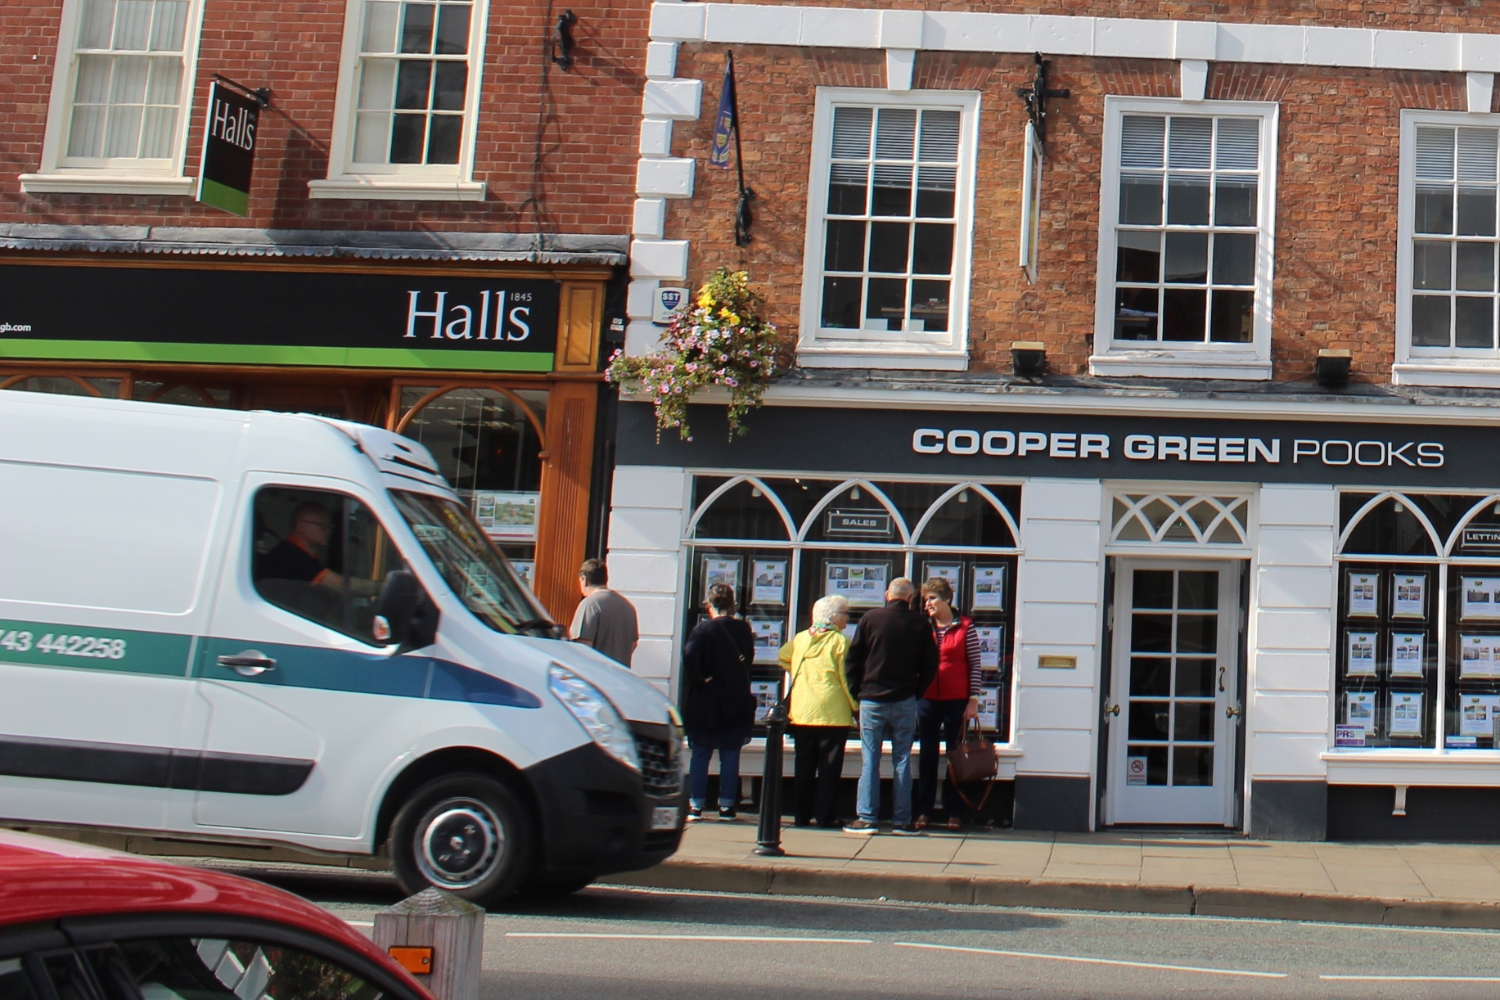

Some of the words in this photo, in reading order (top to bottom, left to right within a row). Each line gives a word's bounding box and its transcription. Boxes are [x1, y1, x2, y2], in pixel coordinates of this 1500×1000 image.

[212, 99, 254, 150] Halls
[510, 293, 532, 301] 1845
[403, 290, 530, 341] Halls
[912, 428, 1110, 458] COOPER
[1124, 434, 1280, 463] GREEN
[1293, 439, 1445, 467] POOKS
[842, 518, 877, 527] SALES
[36, 633, 127, 660] 442258
